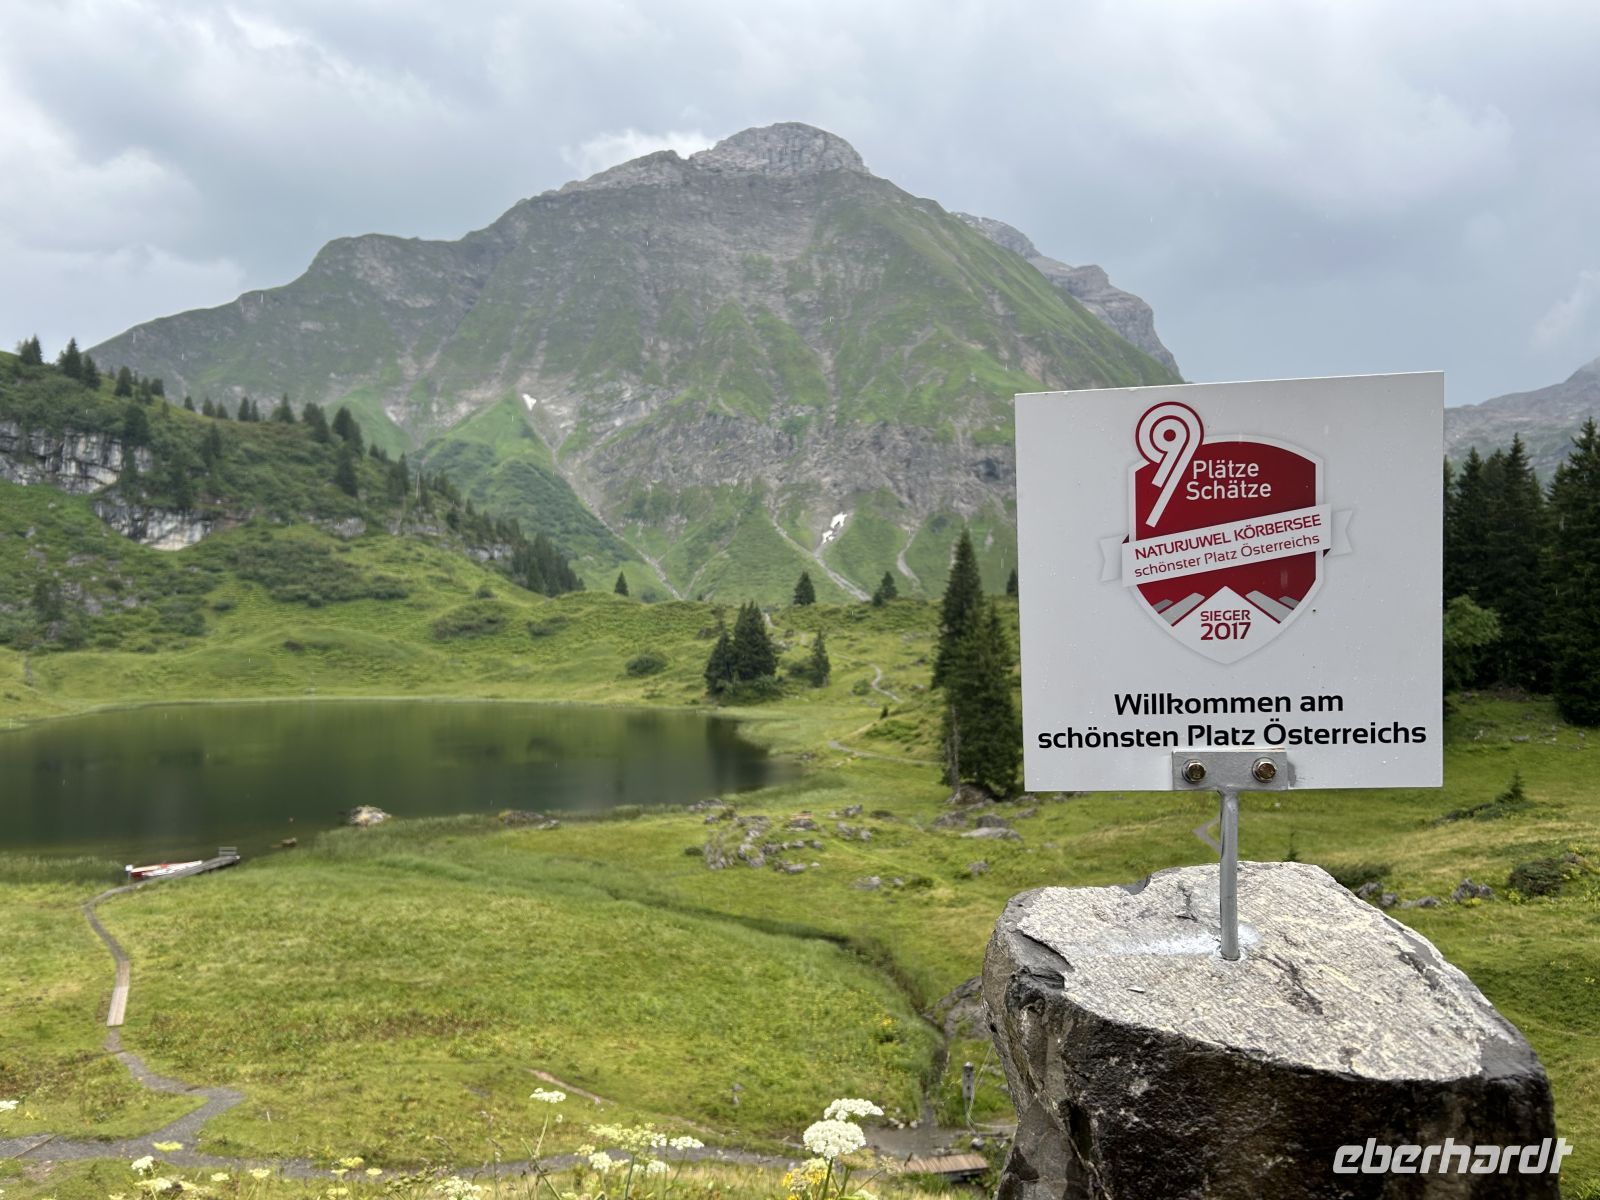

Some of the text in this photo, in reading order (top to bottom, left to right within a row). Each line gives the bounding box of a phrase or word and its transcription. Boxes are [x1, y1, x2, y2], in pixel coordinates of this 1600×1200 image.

[1135, 401, 1204, 528] 9
[1192, 460, 1260, 479] Plätze
[1186, 480, 1272, 501] Schätze
[1135, 514, 1322, 560] NATURJUWEL KÖRBERSEE
[1134, 534, 1320, 577] schönster Platz Österreichs
[1200, 609, 1251, 622] SIEGER
[1200, 622, 1251, 641] 2017
[1114, 693, 1344, 716] Willkommen am
[1038, 718, 1427, 749] schönsten Platz Österreichs
